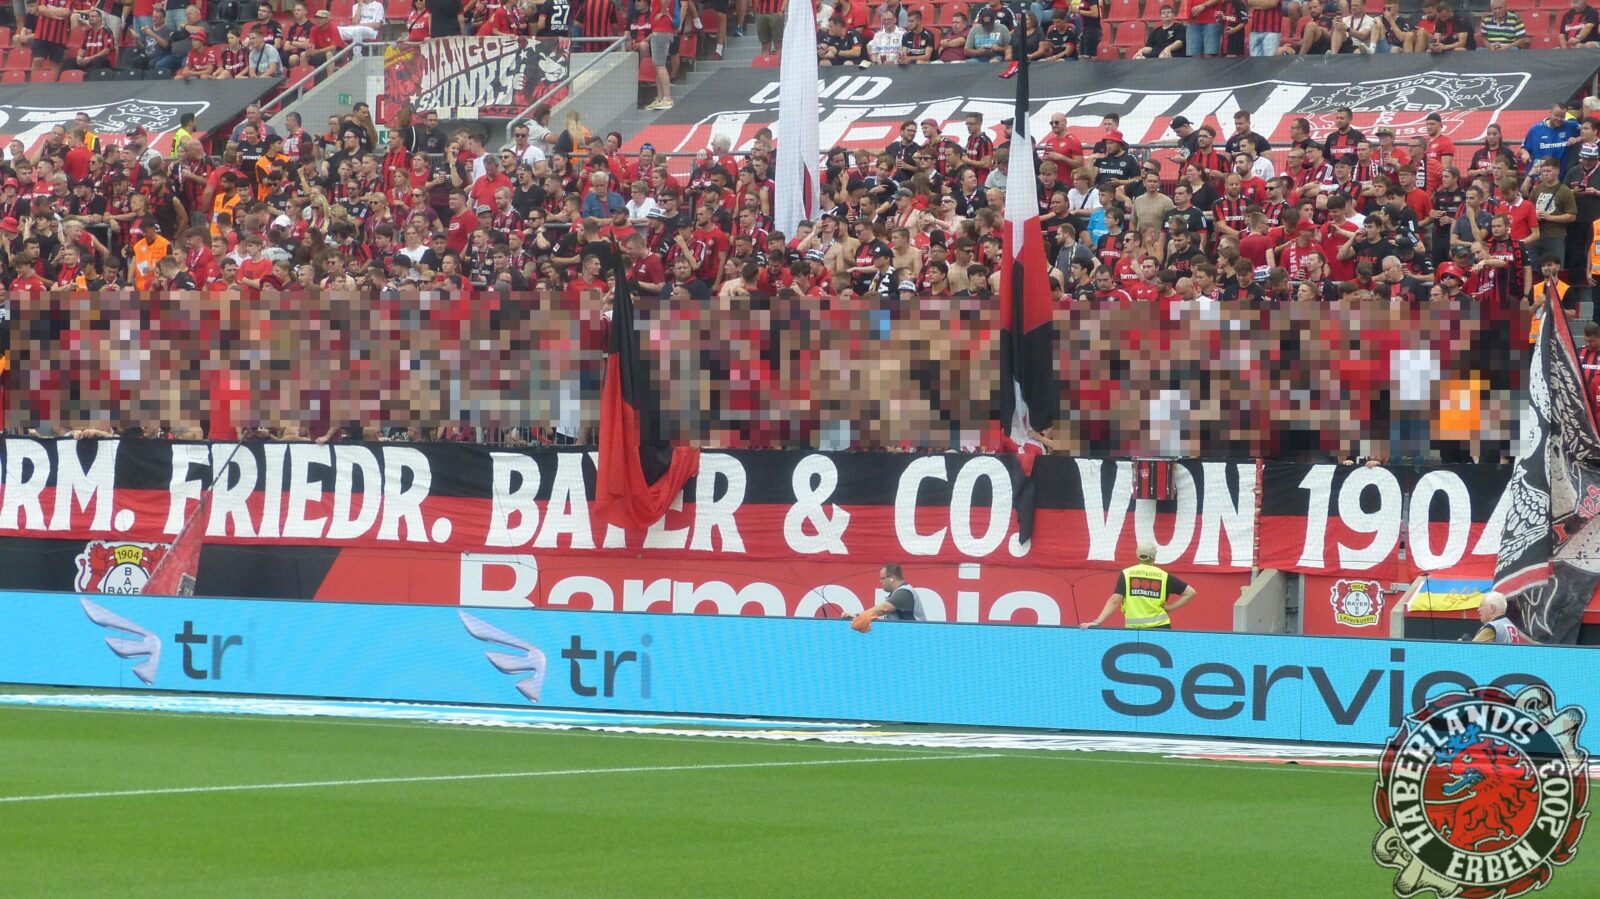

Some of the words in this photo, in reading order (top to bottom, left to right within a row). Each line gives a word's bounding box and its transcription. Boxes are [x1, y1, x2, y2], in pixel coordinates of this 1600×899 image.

[551, 5, 570, 24] 27
[416, 52, 517, 113] SKUNKS
[1394, 78, 1437, 91] 1904
[0, 439, 135, 532] RM.
[163, 443, 453, 543] FRIEDR.
[485, 452, 747, 553] BAR
[783, 453, 851, 555] &
[894, 455, 1031, 558] CO.
[1075, 458, 1257, 567] VON
[117, 549, 140, 560] 1904
[1131, 589, 1160, 597] SECURITAS
[1339, 614, 1375, 624] Leverkusen
